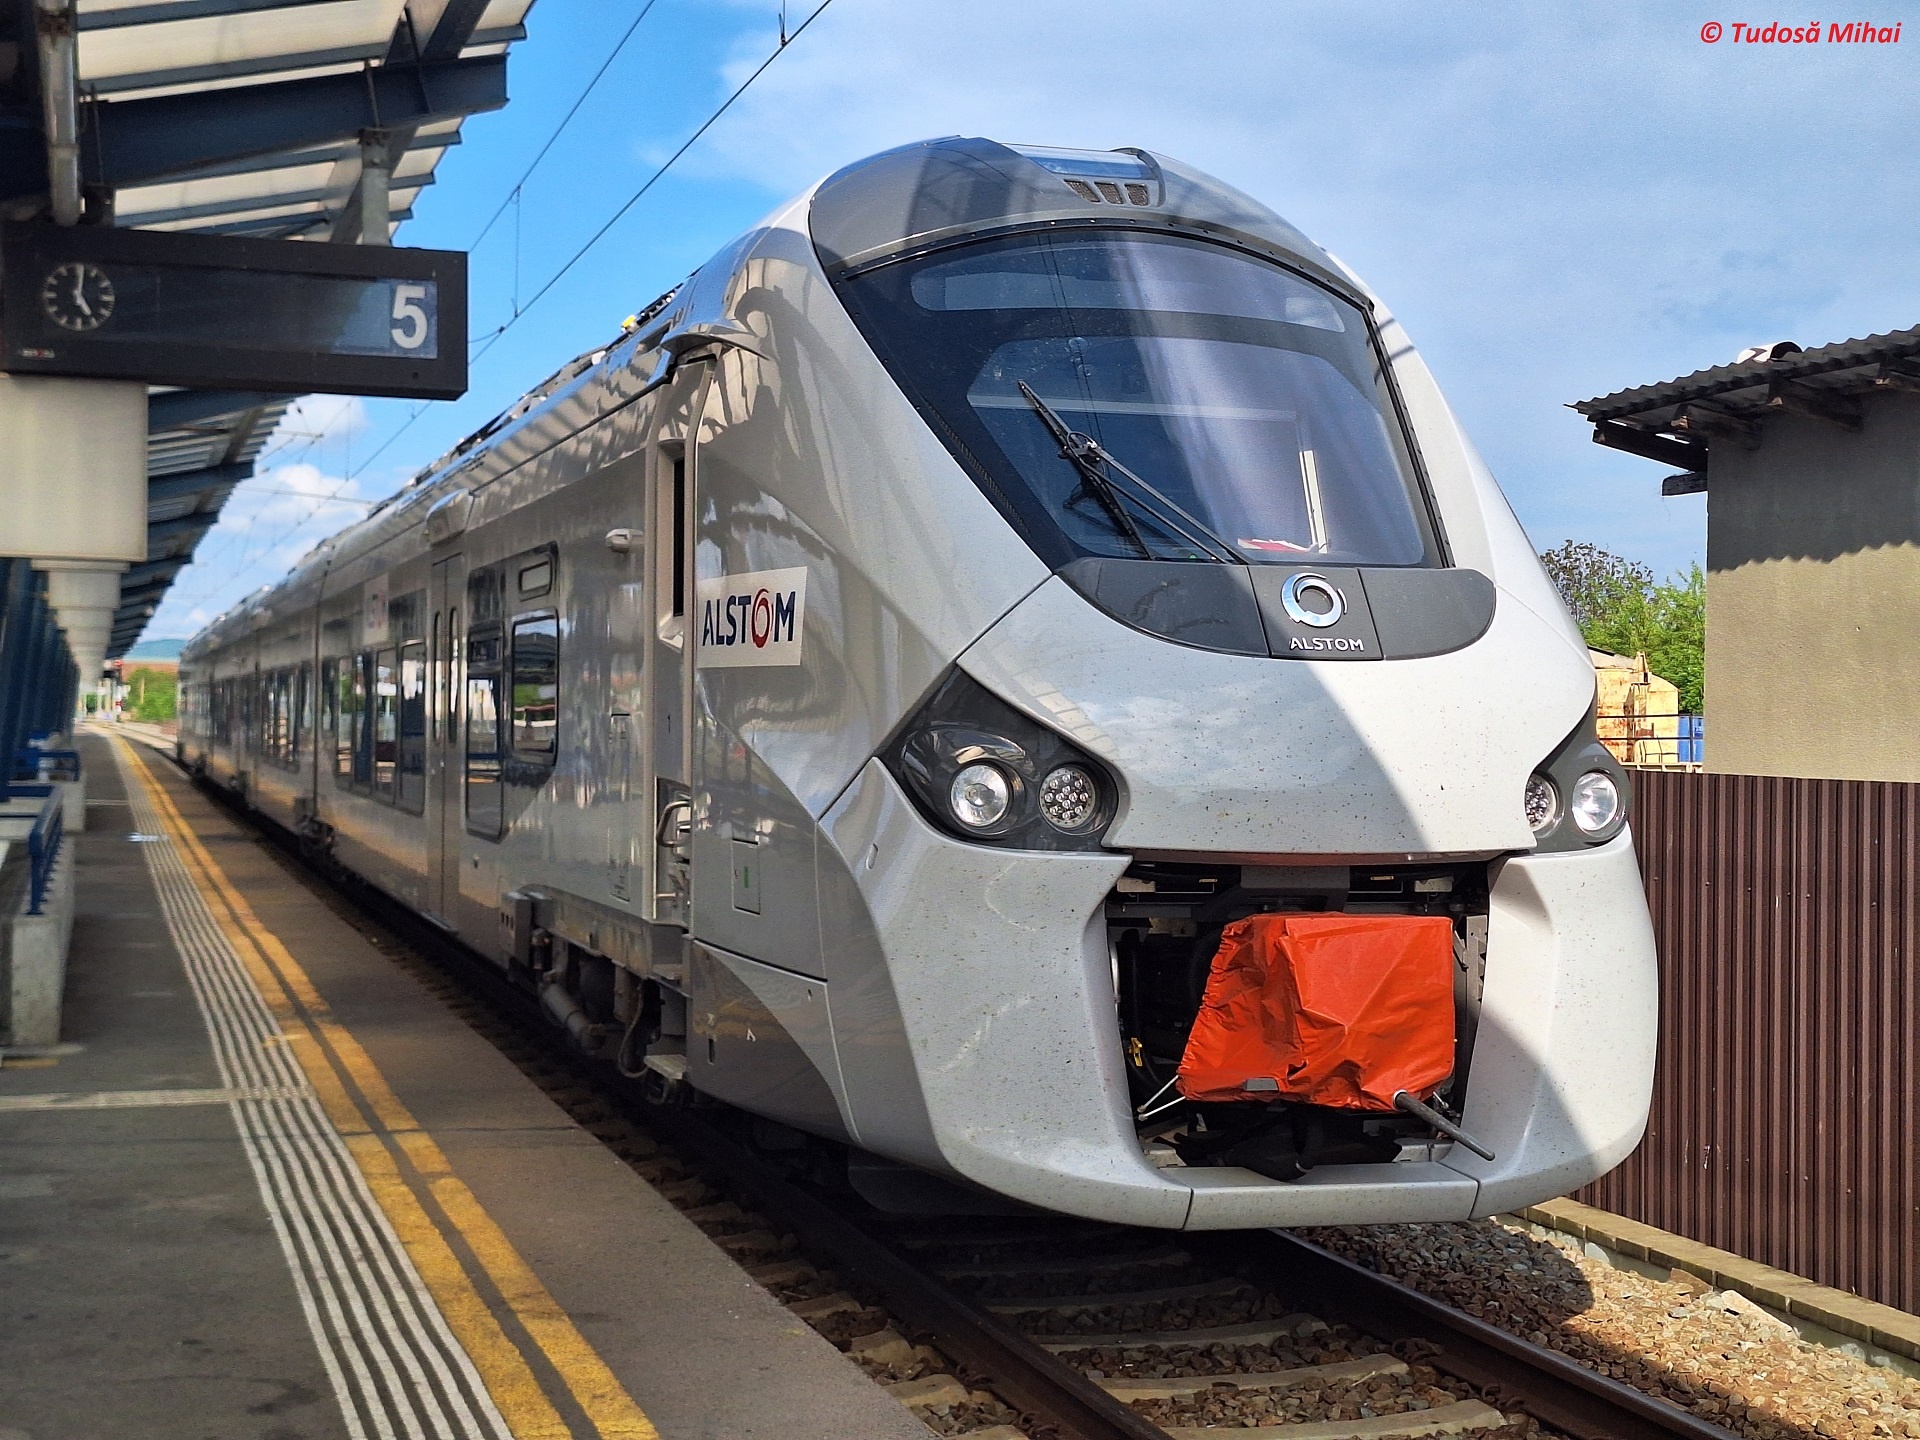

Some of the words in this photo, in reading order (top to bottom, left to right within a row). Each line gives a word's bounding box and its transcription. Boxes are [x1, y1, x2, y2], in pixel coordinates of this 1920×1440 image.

[391, 284, 428, 349] 5
[702, 588, 796, 648] ALSTOM
[1289, 637, 1365, 651] ALSTOM
